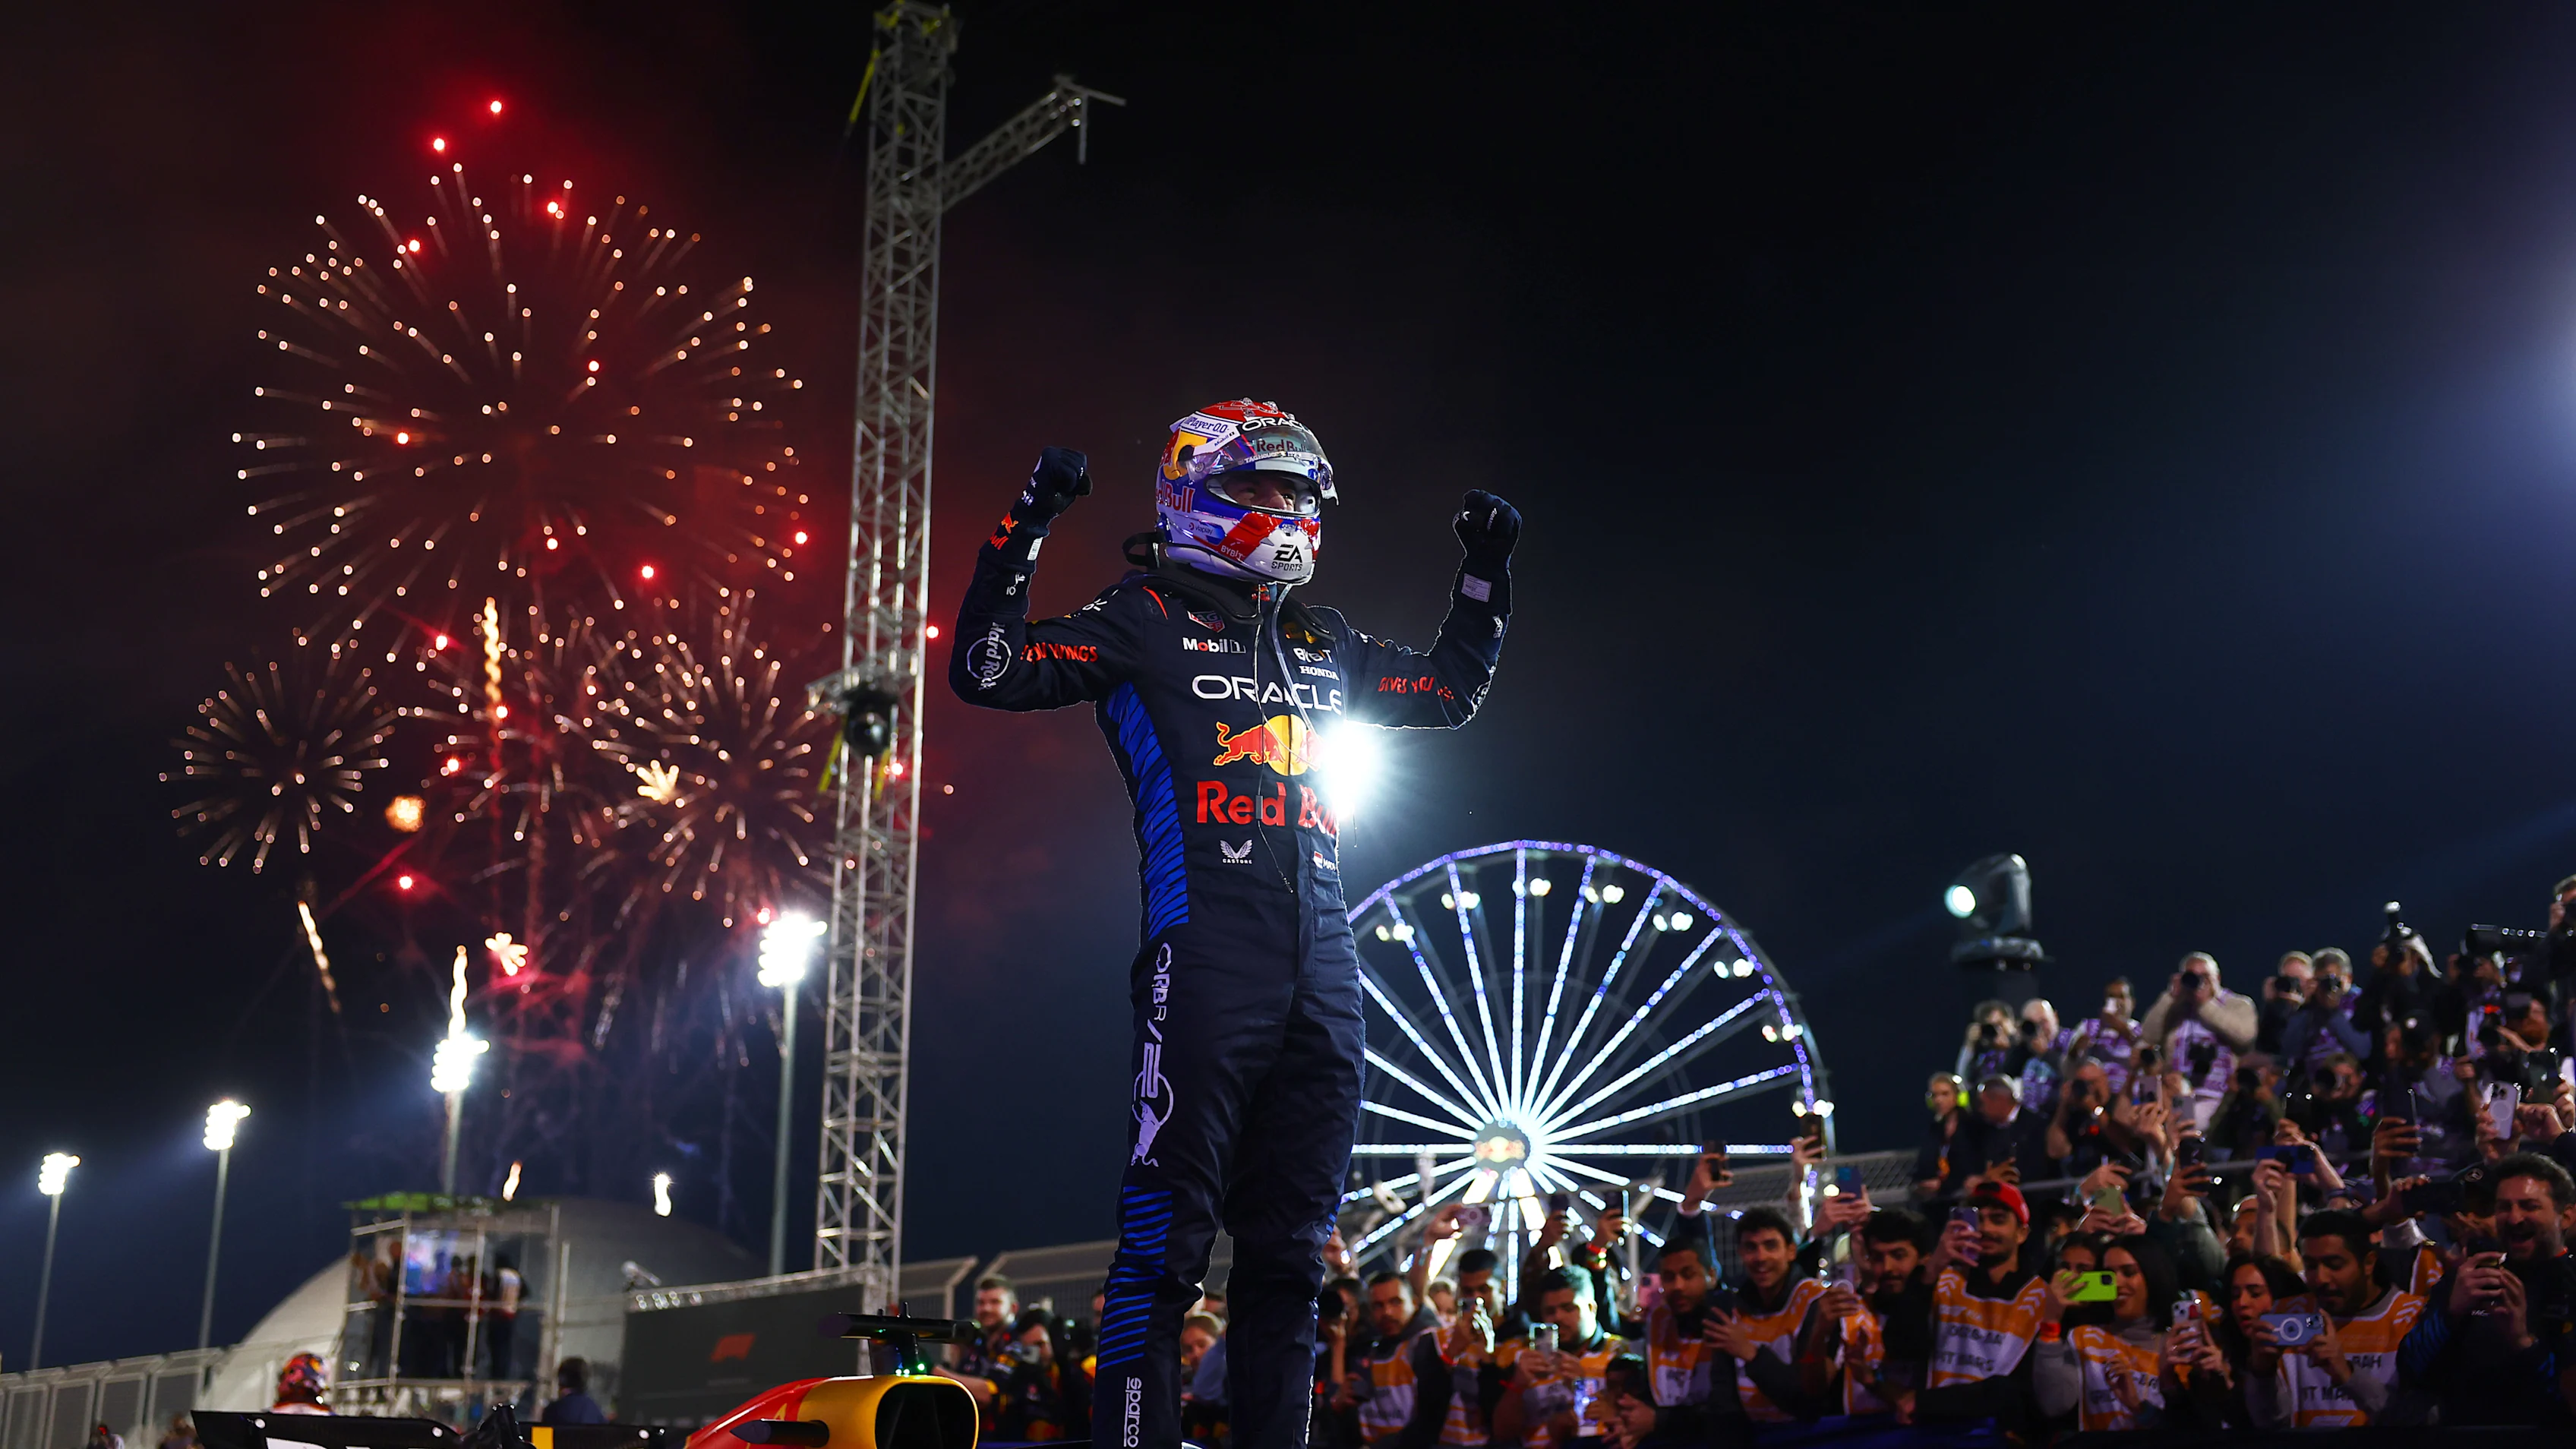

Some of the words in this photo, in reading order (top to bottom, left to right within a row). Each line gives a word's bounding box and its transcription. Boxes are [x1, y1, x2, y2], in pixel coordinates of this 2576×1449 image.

[1242, 417, 1314, 435] ORACL
[1257, 440, 1284, 452] Red
[1165, 481, 1195, 513] Bull
[1273, 543, 1303, 563] EA
[1271, 561, 1303, 572] SPORTS
[987, 622, 1005, 660] Hard
[1182, 637, 1228, 652] Mobil
[1048, 643, 1098, 662] WINGS
[1299, 665, 1340, 681] HONDA
[1192, 674, 1343, 716] ORACLE
[1196, 780, 1287, 827] Red
[1124, 1376, 1142, 1448] sparco
